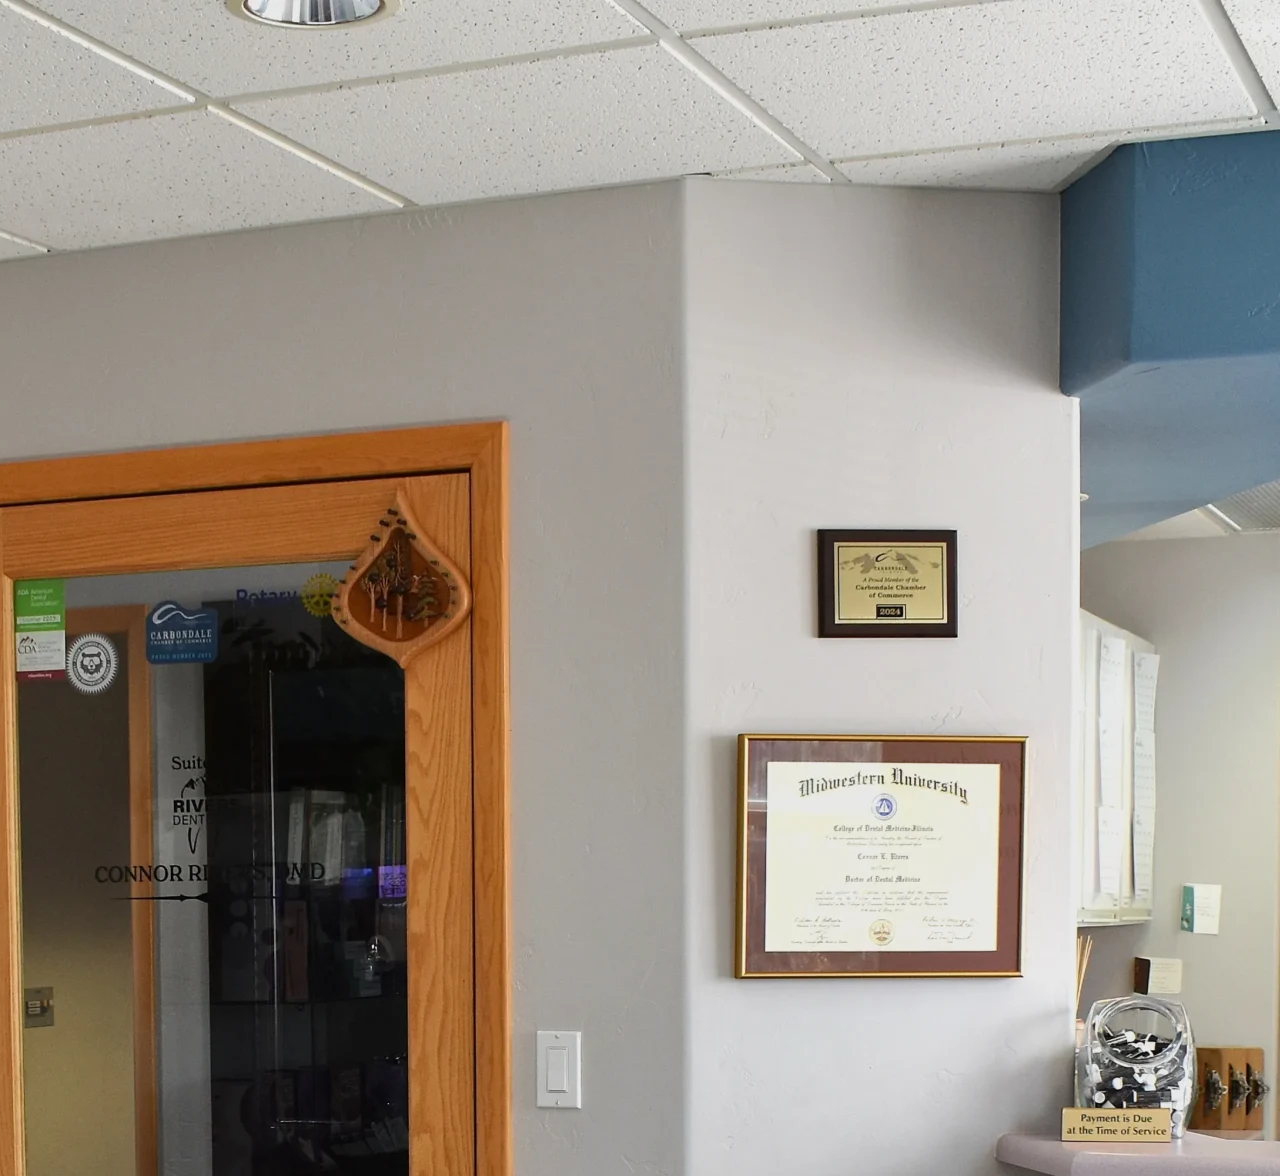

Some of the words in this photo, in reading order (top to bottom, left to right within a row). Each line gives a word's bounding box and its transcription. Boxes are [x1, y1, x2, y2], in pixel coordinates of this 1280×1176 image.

[236, 589, 297, 603] Rotary
[151, 629, 212, 640] CARBONDALE
[18, 645, 37, 654] CDA
[799, 770, 885, 797] Midwestern
[891, 767, 969, 804] University
[173, 815, 205, 826] DENT
[95, 865, 183, 883] CONNOR
[1081, 1114, 1120, 1124] Payment
[1123, 1114, 1130, 1123] is
[1133, 1114, 1152, 1123] Due
[1079, 1127, 1094, 1135] the
[1096, 1127, 1118, 1135] Time
[1120, 1127, 1130, 1135] of
[1133, 1127, 1167, 1135] Service
